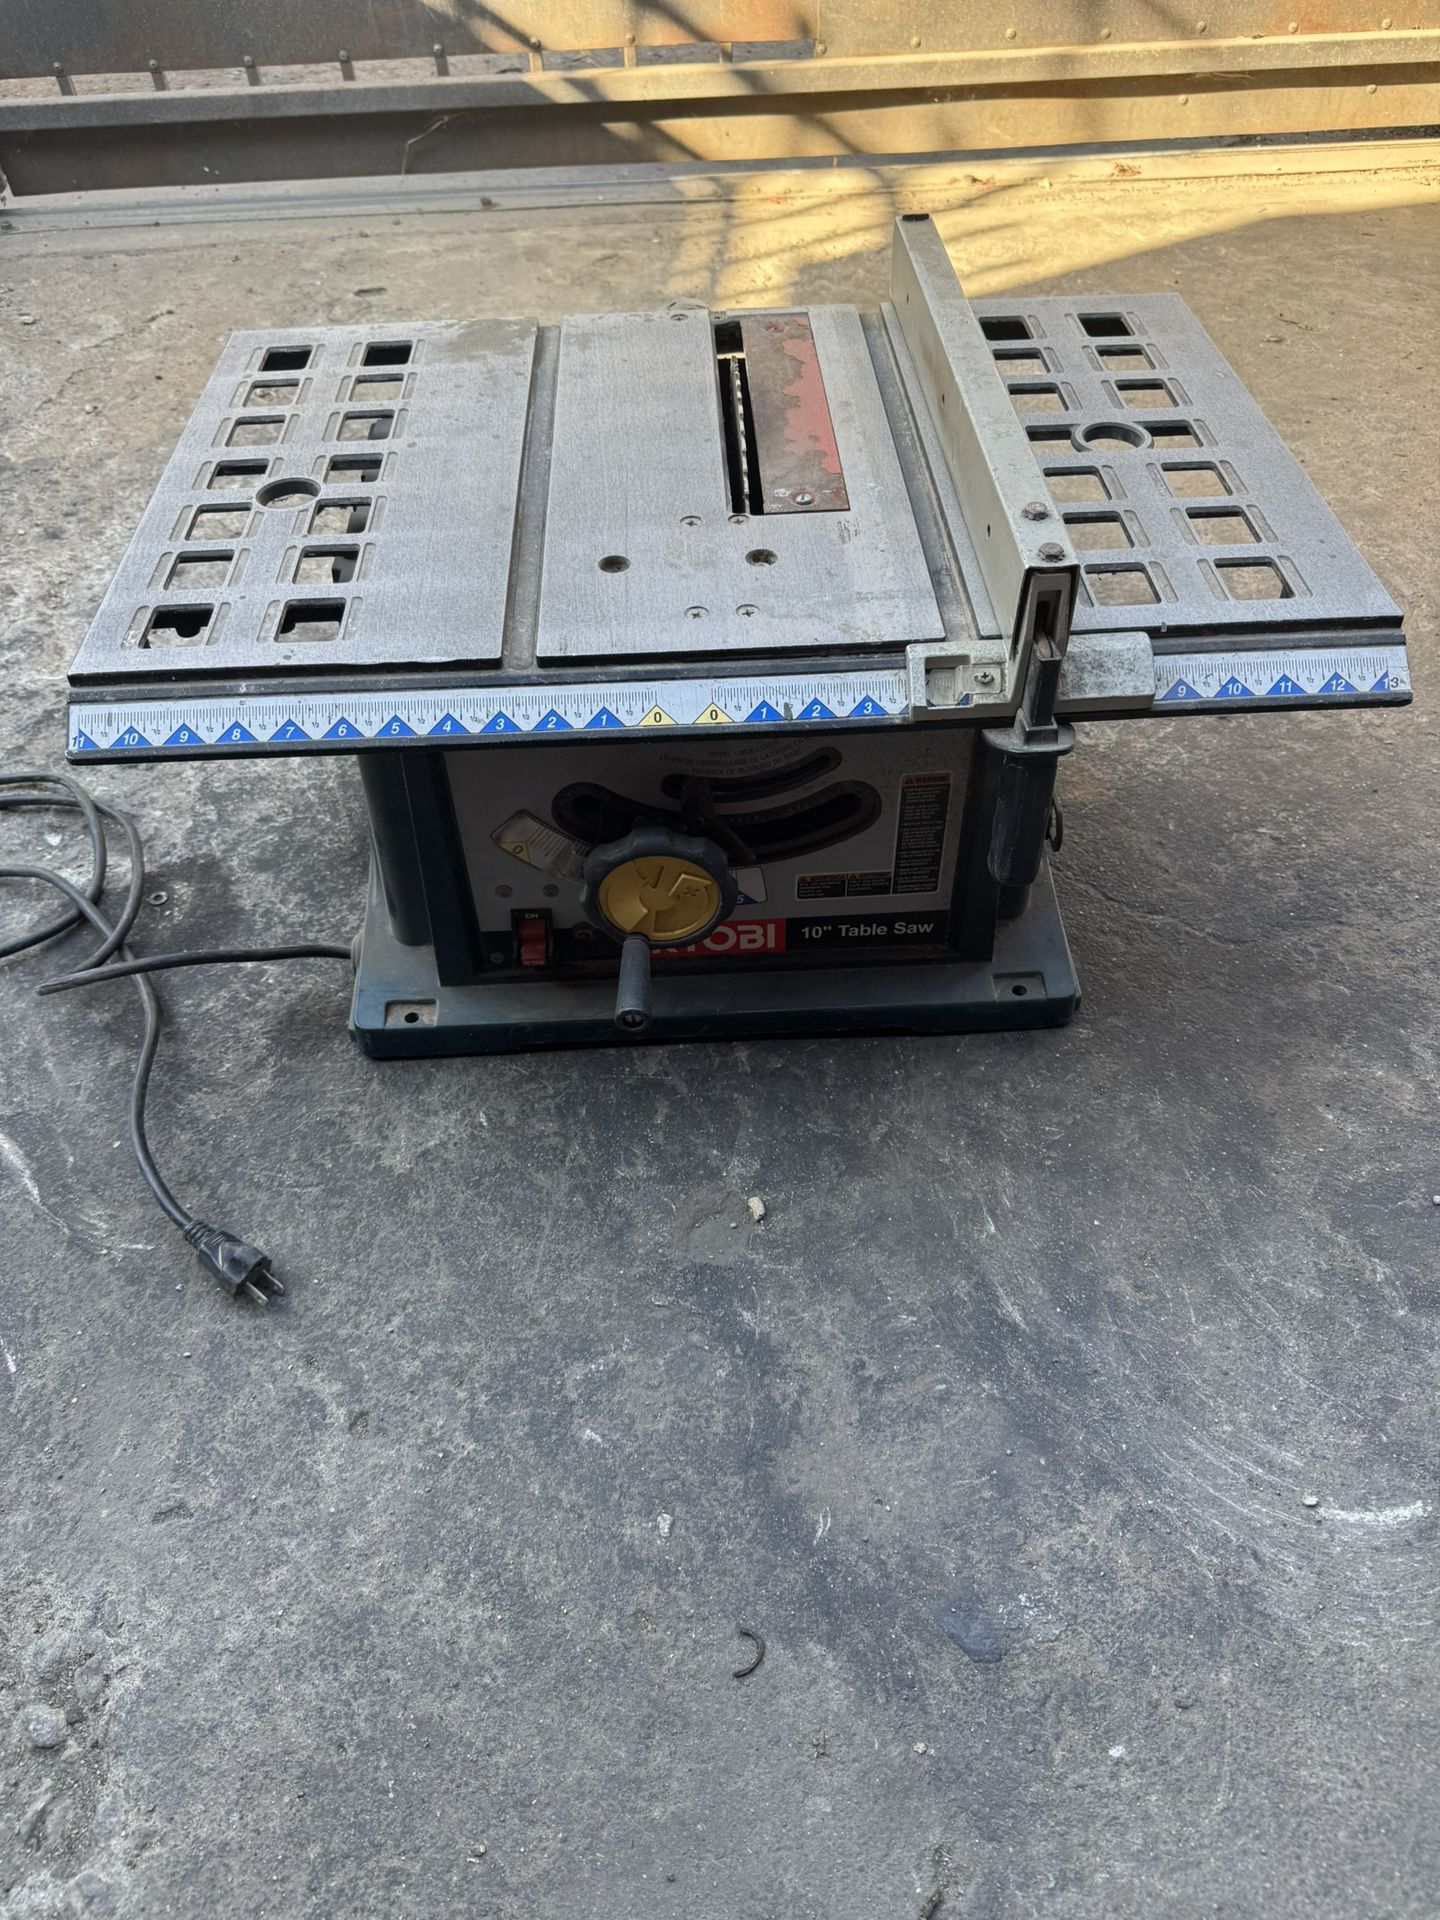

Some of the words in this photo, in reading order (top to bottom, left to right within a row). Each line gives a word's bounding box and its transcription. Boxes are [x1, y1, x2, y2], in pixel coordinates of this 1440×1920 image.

[1177, 685, 1187, 697] 9
[1226, 682, 1242, 695] 10
[1279, 681, 1293, 693] 11
[1330, 679, 1346, 691] 12
[1382, 676, 1400, 689] 13
[709, 709, 718, 721] 0
[760, 707, 768, 719] 1
[811, 705, 821, 716] 2
[863, 702, 873, 714] 3
[72, 736, 85, 747] 11
[123, 733, 138, 745] 10
[179, 731, 189, 743] 9
[231, 728, 241, 740] 8
[285, 726, 296, 738] 7
[338, 724, 348, 736] 6
[390, 722, 401, 734] 5
[442, 720, 452, 732] 4
[495, 718, 505, 730] 3
[546, 716, 557, 728] 2
[600, 714, 607, 726] 1
[653, 711, 662, 723] 0
[511, 844, 524, 855] 0
[800, 925, 832, 939] 10"
[838, 923, 888, 937] Table
[893, 921, 934, 935] Saw
